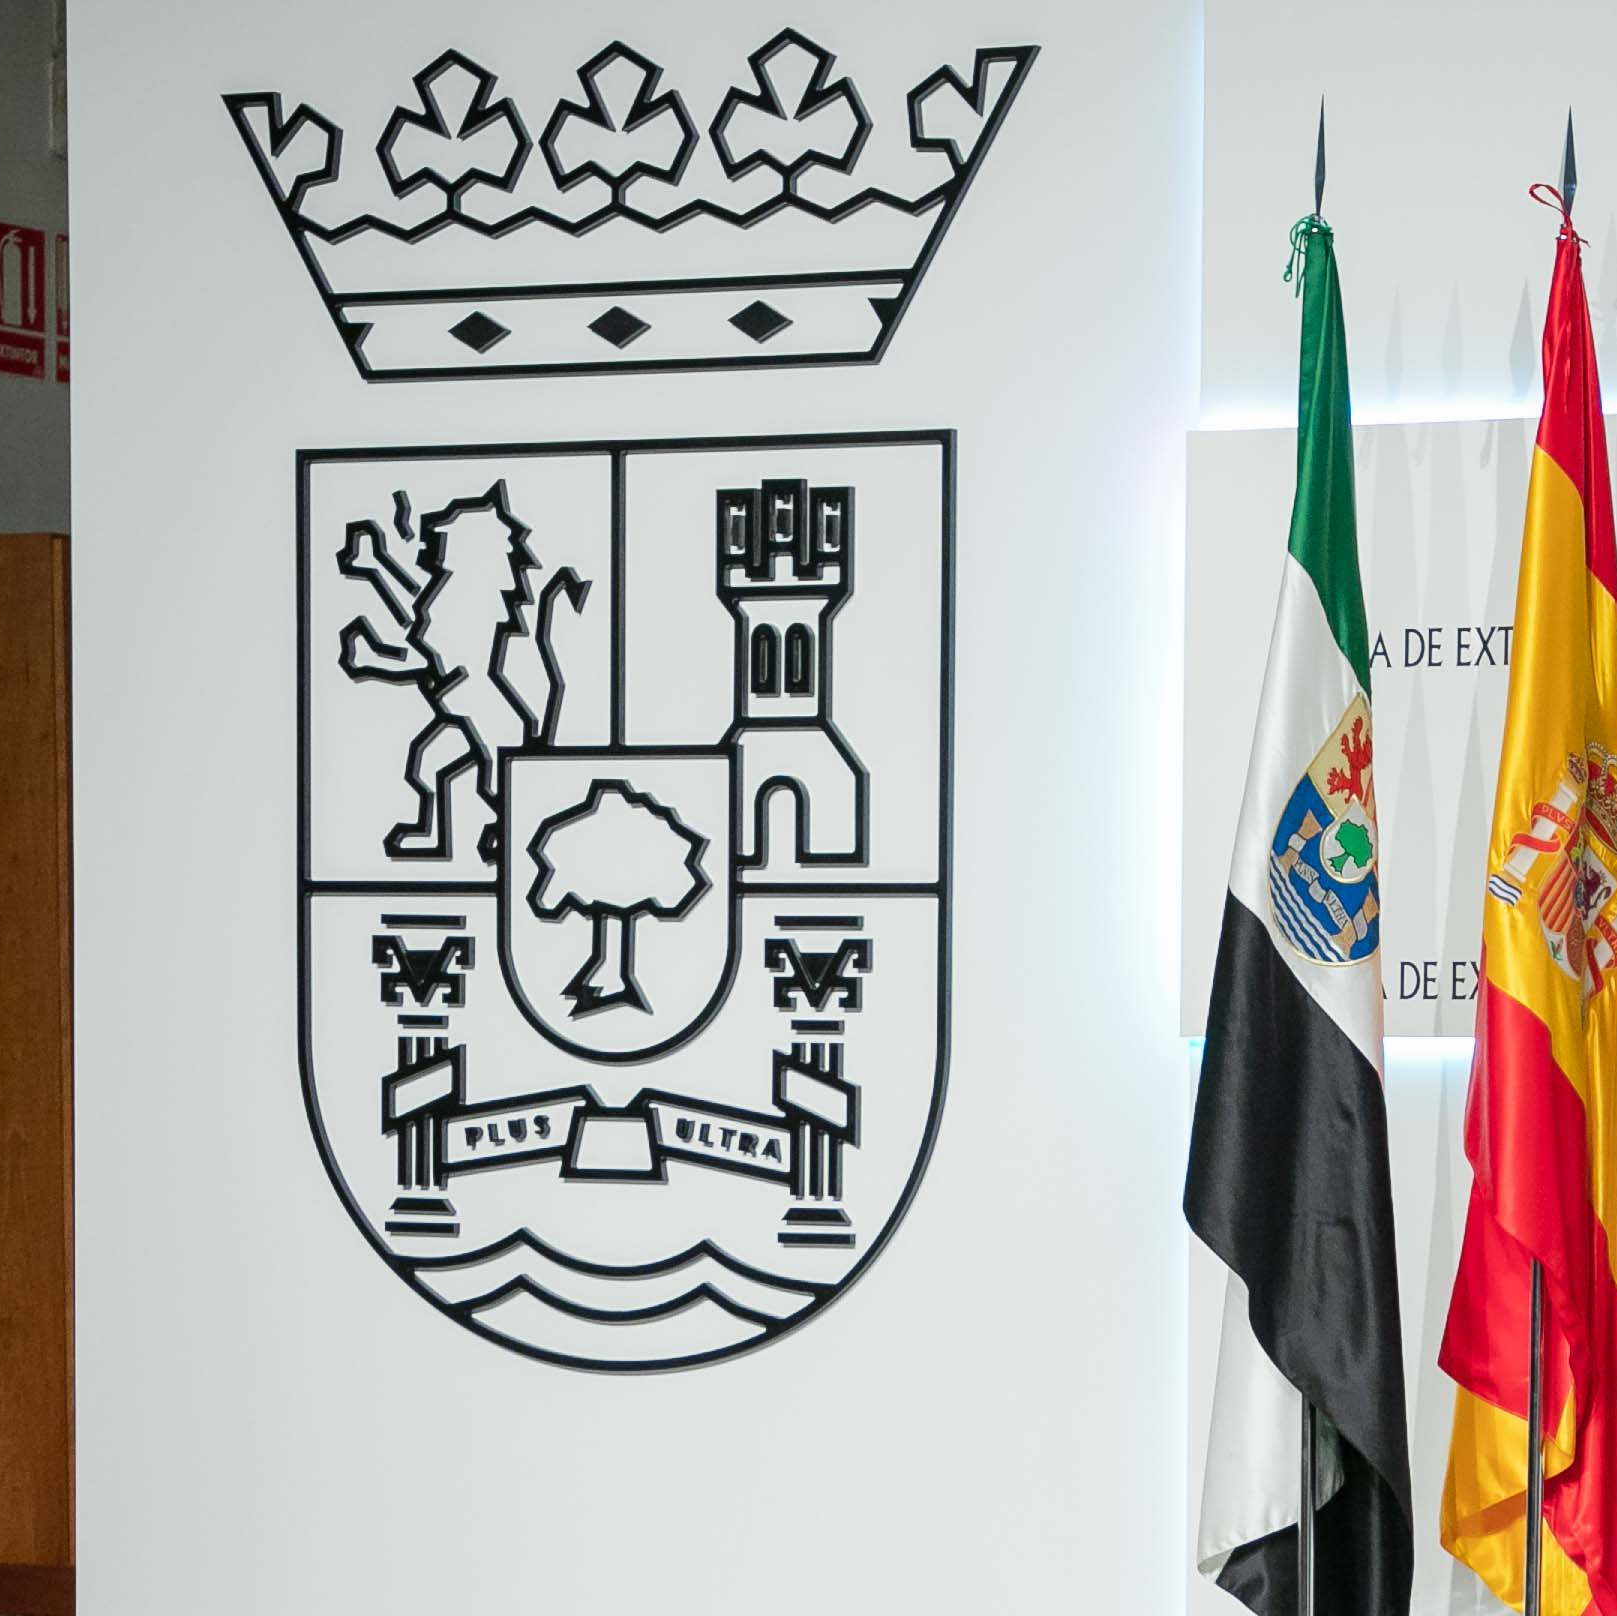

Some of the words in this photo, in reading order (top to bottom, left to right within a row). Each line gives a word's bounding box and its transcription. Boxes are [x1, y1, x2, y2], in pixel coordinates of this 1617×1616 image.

[1404, 627, 1444, 668] DE
[1399, 961, 1439, 1000] DE
[464, 1115, 551, 1150] PLUS
[675, 1117, 782, 1163] ULTRA
